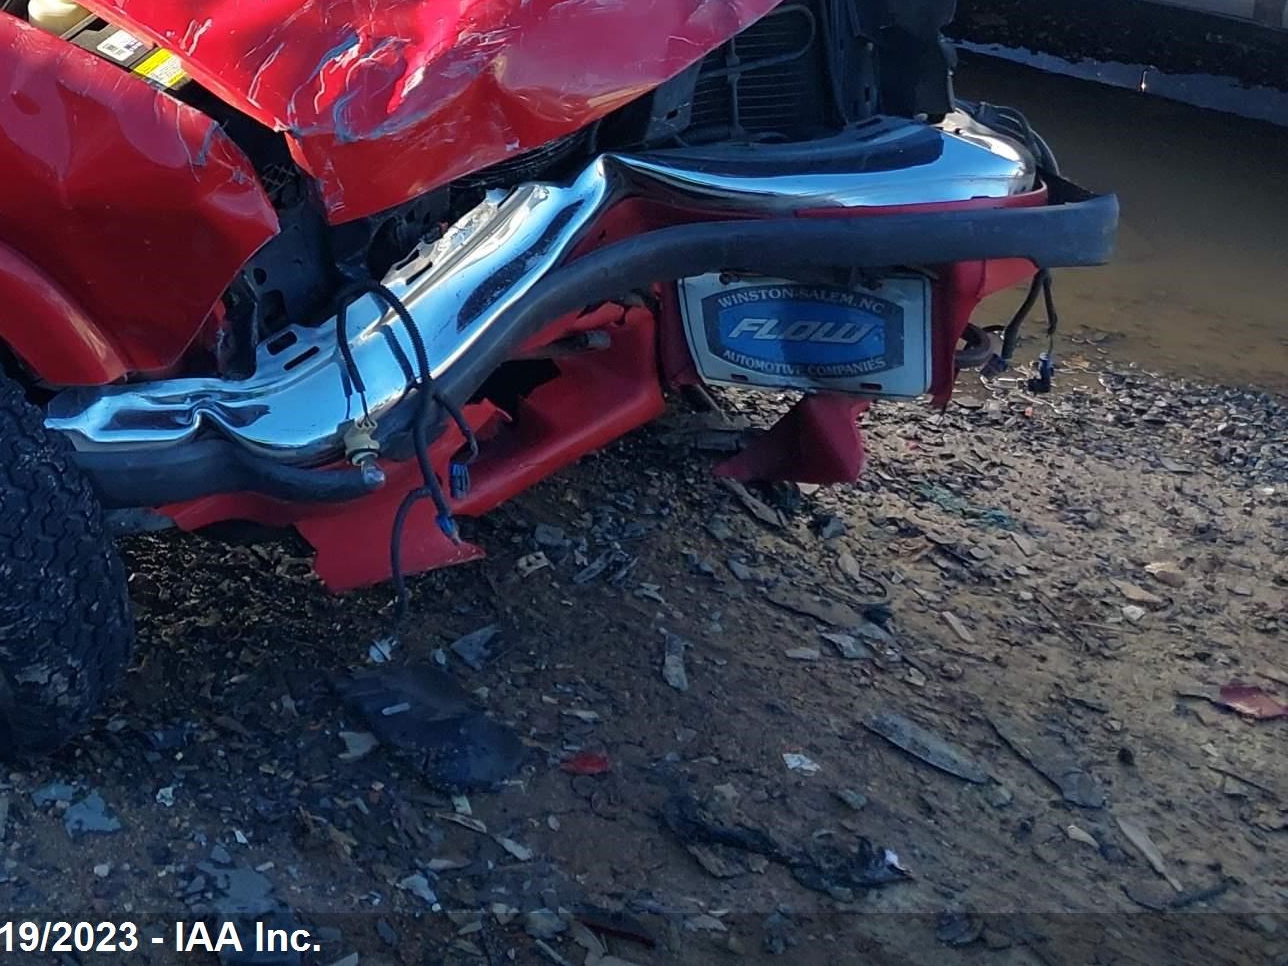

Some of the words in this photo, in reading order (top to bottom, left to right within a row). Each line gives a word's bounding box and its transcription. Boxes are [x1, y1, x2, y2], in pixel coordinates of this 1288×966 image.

[859, 297, 885, 314] NC
[728, 317, 872, 344] FLOW
[723, 349, 803, 376] AUTOMOTIVE
[807, 356, 886, 376] COMPANIES
